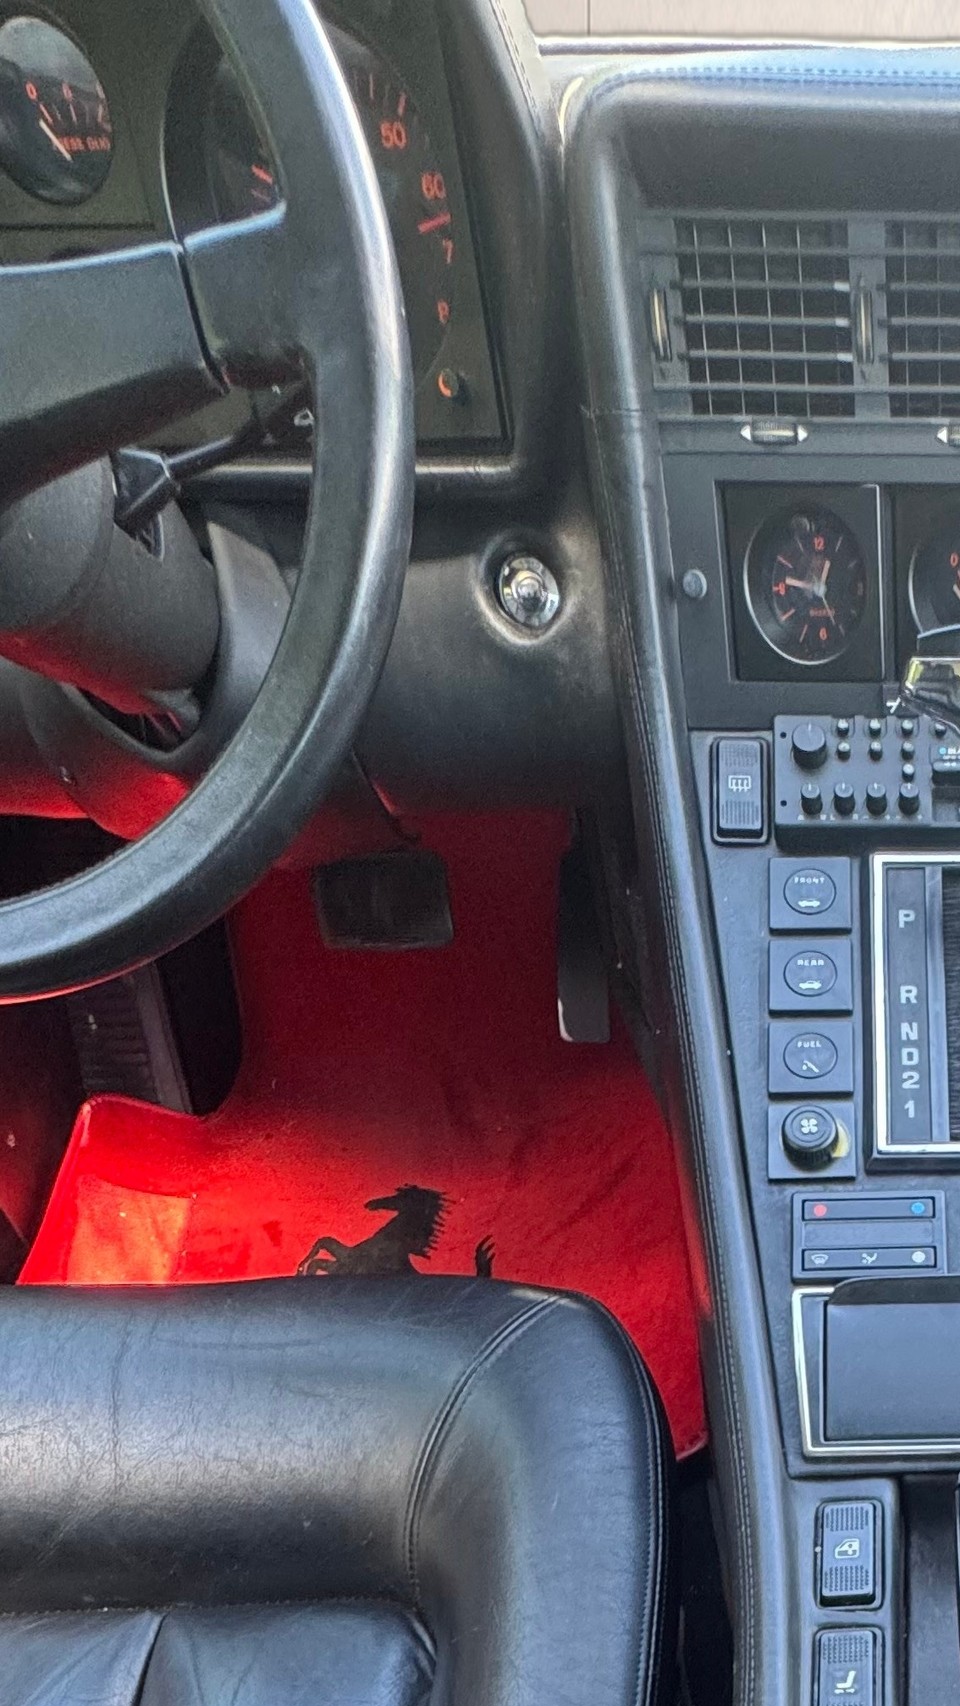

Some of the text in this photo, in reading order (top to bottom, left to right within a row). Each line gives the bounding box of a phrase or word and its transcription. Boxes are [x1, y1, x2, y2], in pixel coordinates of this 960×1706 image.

[380, 121, 407, 149] 50
[421, 171, 447, 199] 60
[898, 909, 916, 928] P
[900, 985, 918, 1004] R
[901, 1022, 919, 1041] N
[902, 1048, 920, 1066] D
[902, 1071, 920, 1089] 2
[904, 1100, 915, 1118] 1
